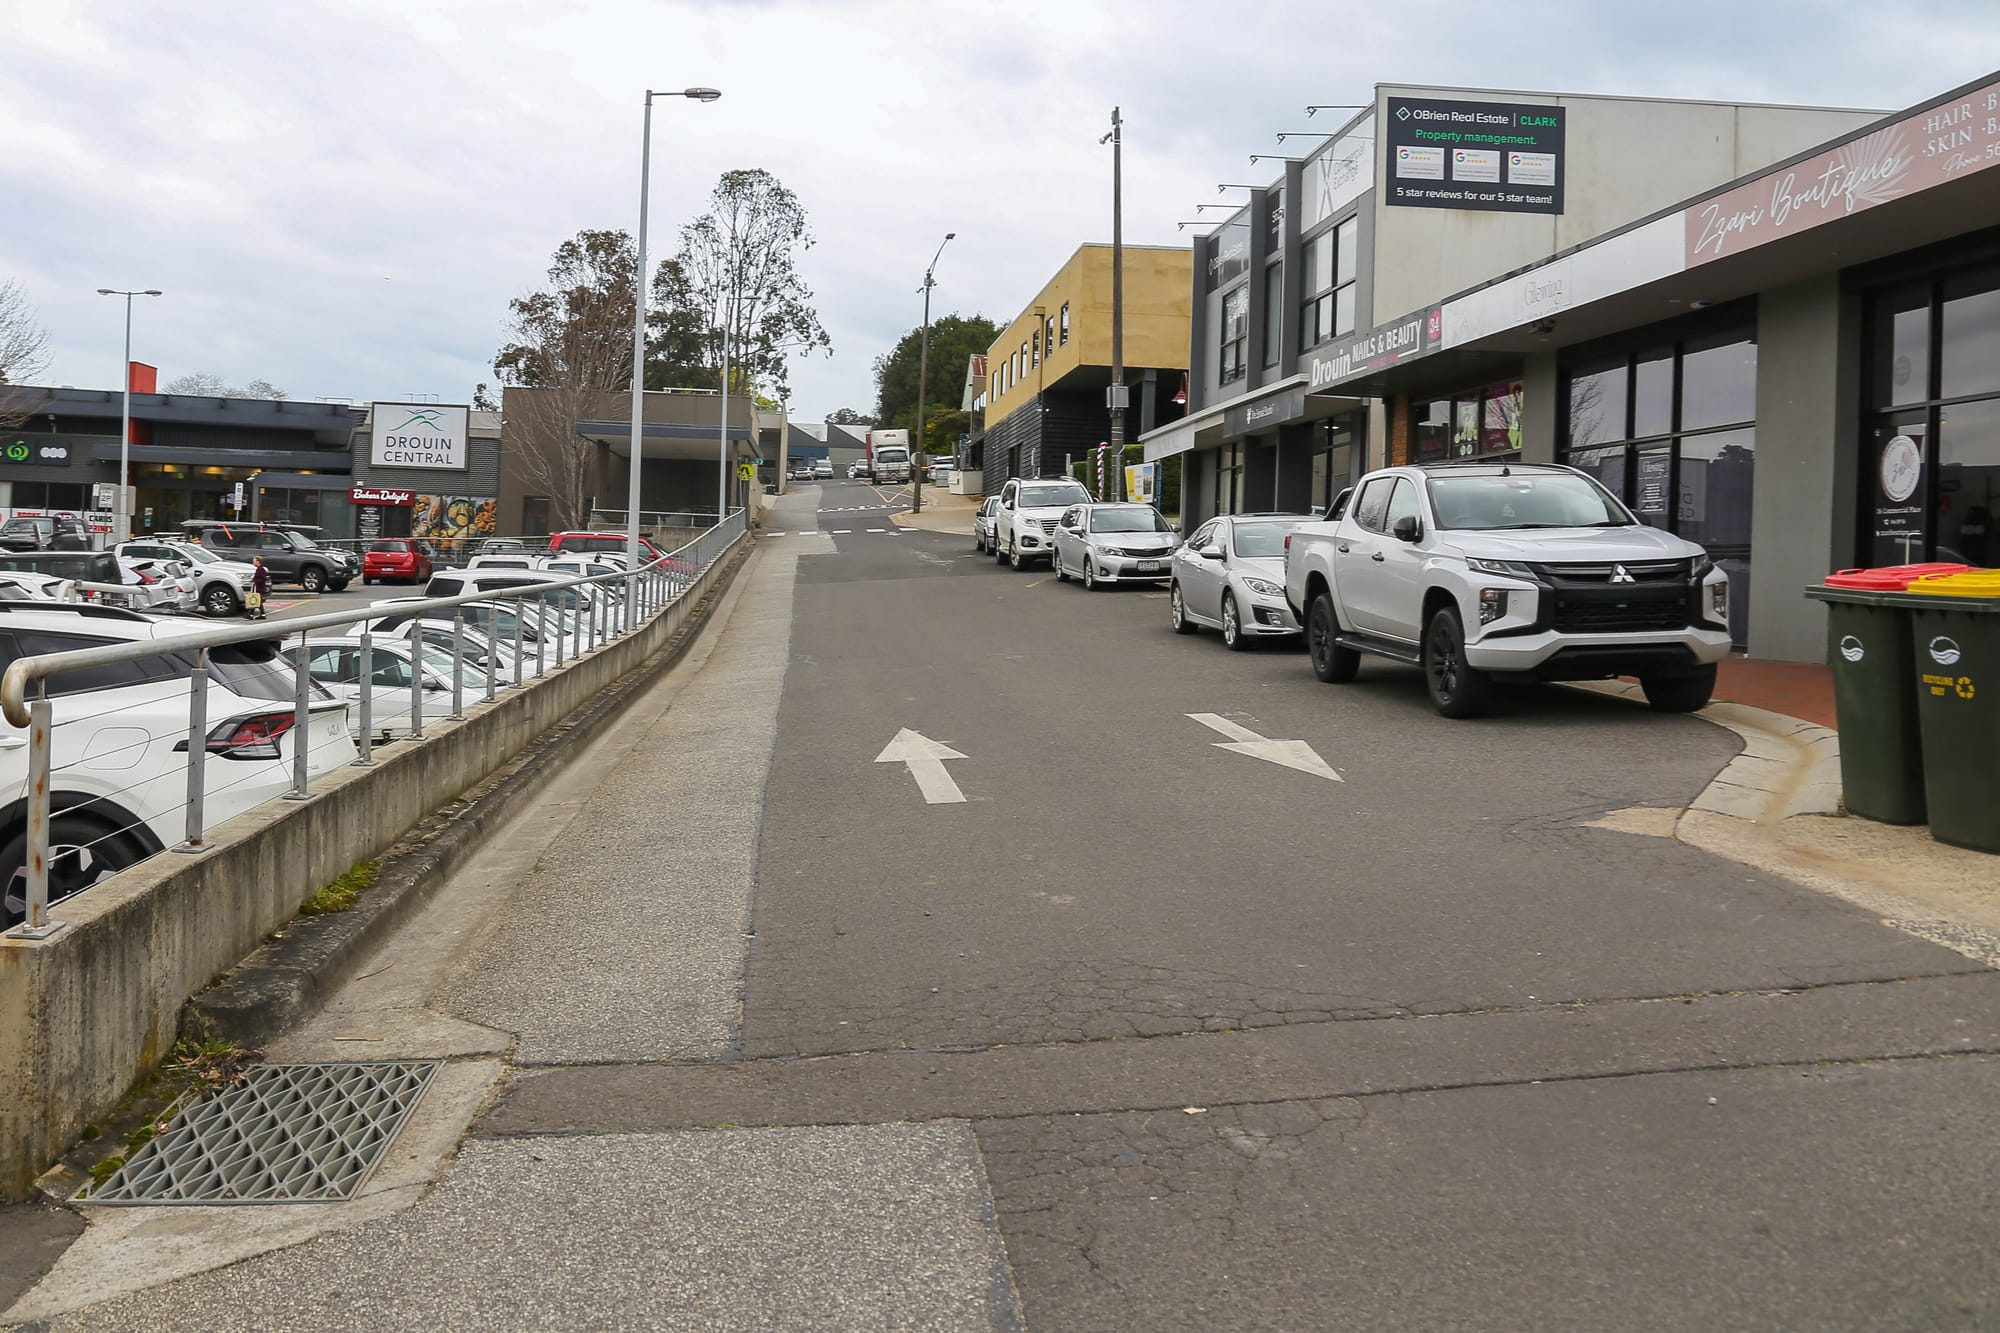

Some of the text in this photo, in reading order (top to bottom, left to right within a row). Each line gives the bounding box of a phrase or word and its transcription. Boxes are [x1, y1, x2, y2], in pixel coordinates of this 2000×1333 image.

[1413, 109, 1557, 127] OBrien Real Estate CLARK
[1415, 129, 1461, 143] Property
[1396, 187, 1553, 204] 5 star reviews for our 5 star team!
[1770, 155, 1901, 226] Boutique
[1311, 348, 1351, 388] Drouin
[1352, 336, 1376, 363] NAILS
[1377, 334, 1385, 354] &
[1386, 319, 1423, 351] BEAUTY
[386, 435, 452, 450] DROUIN
[383, 450, 453, 465] CENTRAL
[353, 489, 409, 504] Bakers Delight
